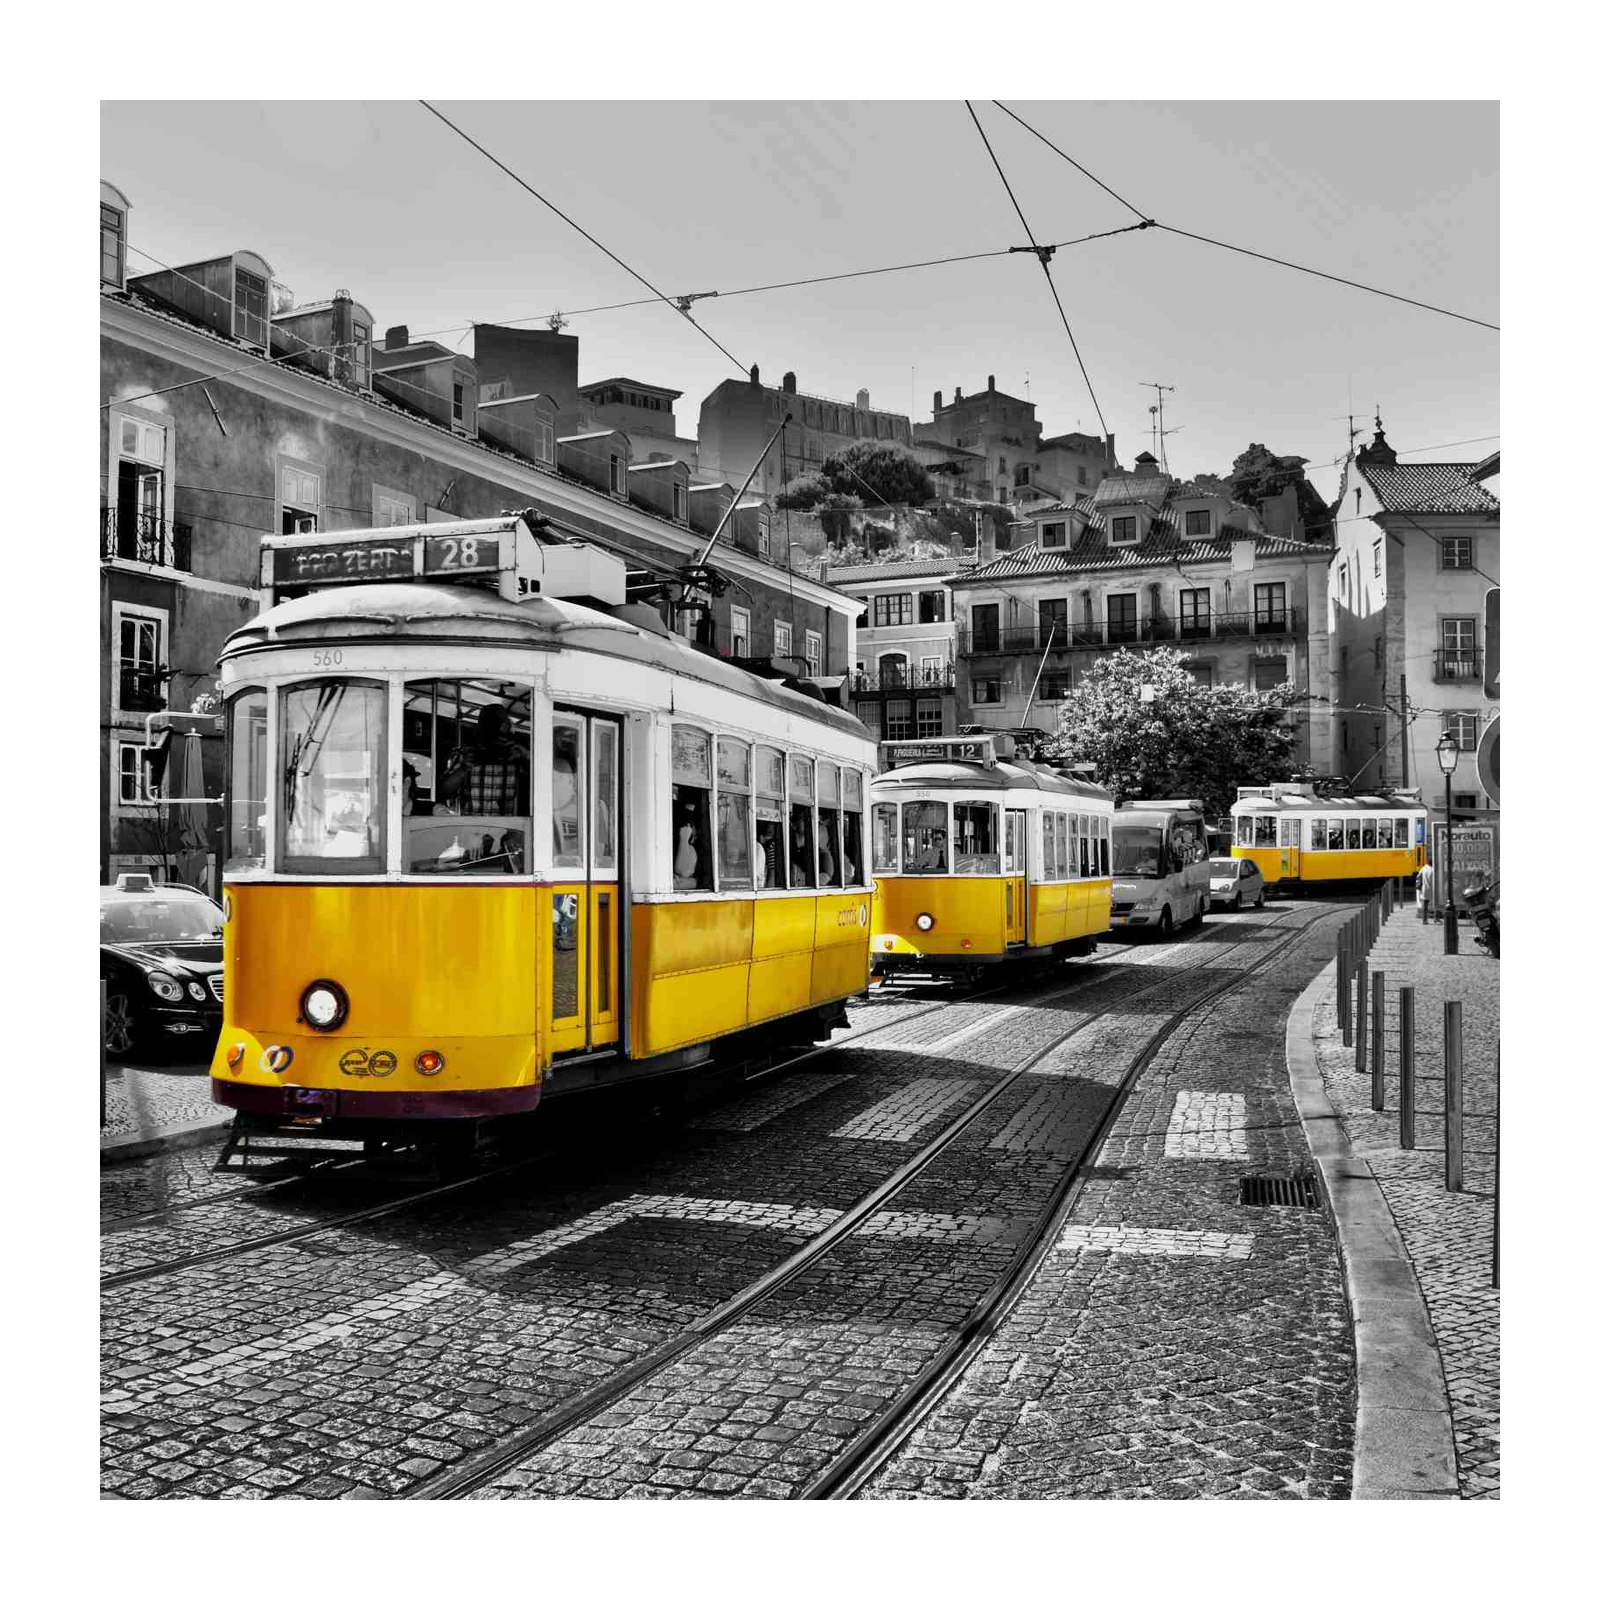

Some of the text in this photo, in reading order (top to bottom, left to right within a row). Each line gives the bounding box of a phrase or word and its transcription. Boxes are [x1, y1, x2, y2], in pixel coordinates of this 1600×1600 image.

[440, 539, 478, 568] 28
[313, 650, 343, 665] 560
[960, 744, 975, 758] 12
[1441, 830, 1491, 841] Norauto
